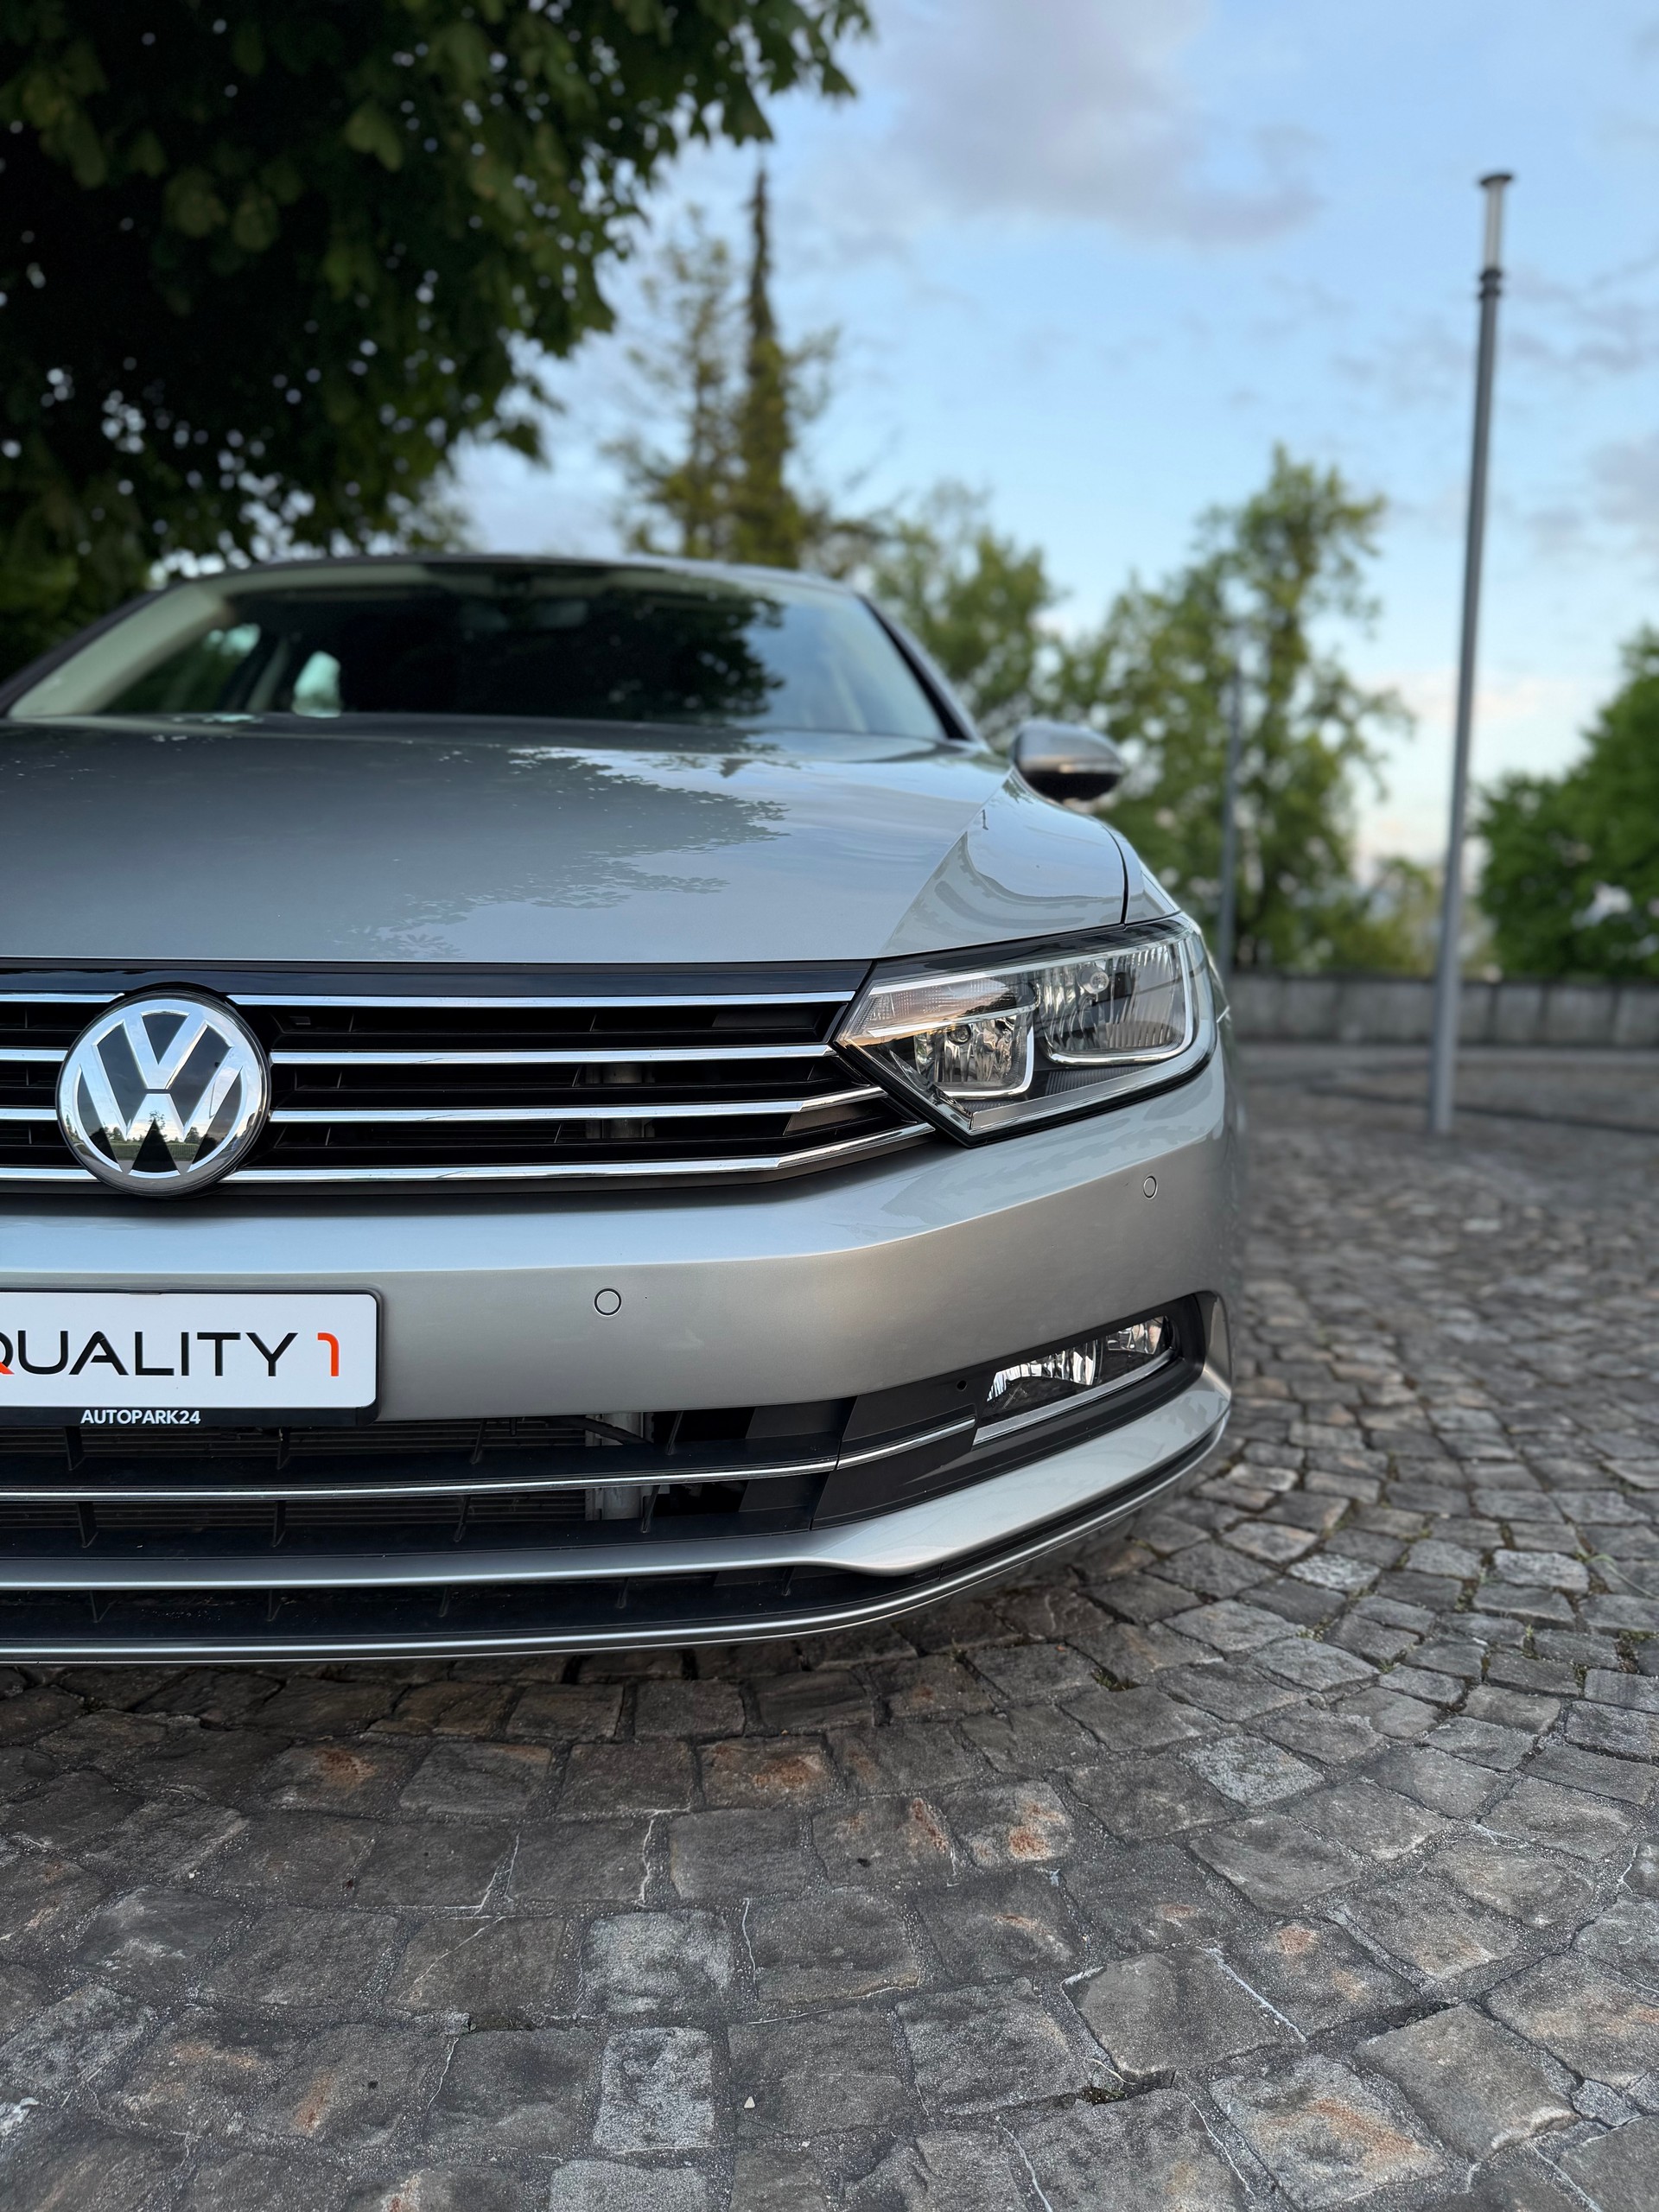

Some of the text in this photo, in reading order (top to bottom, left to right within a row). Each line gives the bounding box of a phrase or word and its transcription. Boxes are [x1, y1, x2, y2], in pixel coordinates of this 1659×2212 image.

[69, 1002, 255, 1180] VW
[0, 1330, 340, 1377] UALITY 1
[80, 1409, 201, 1425] AUTOPARK24
